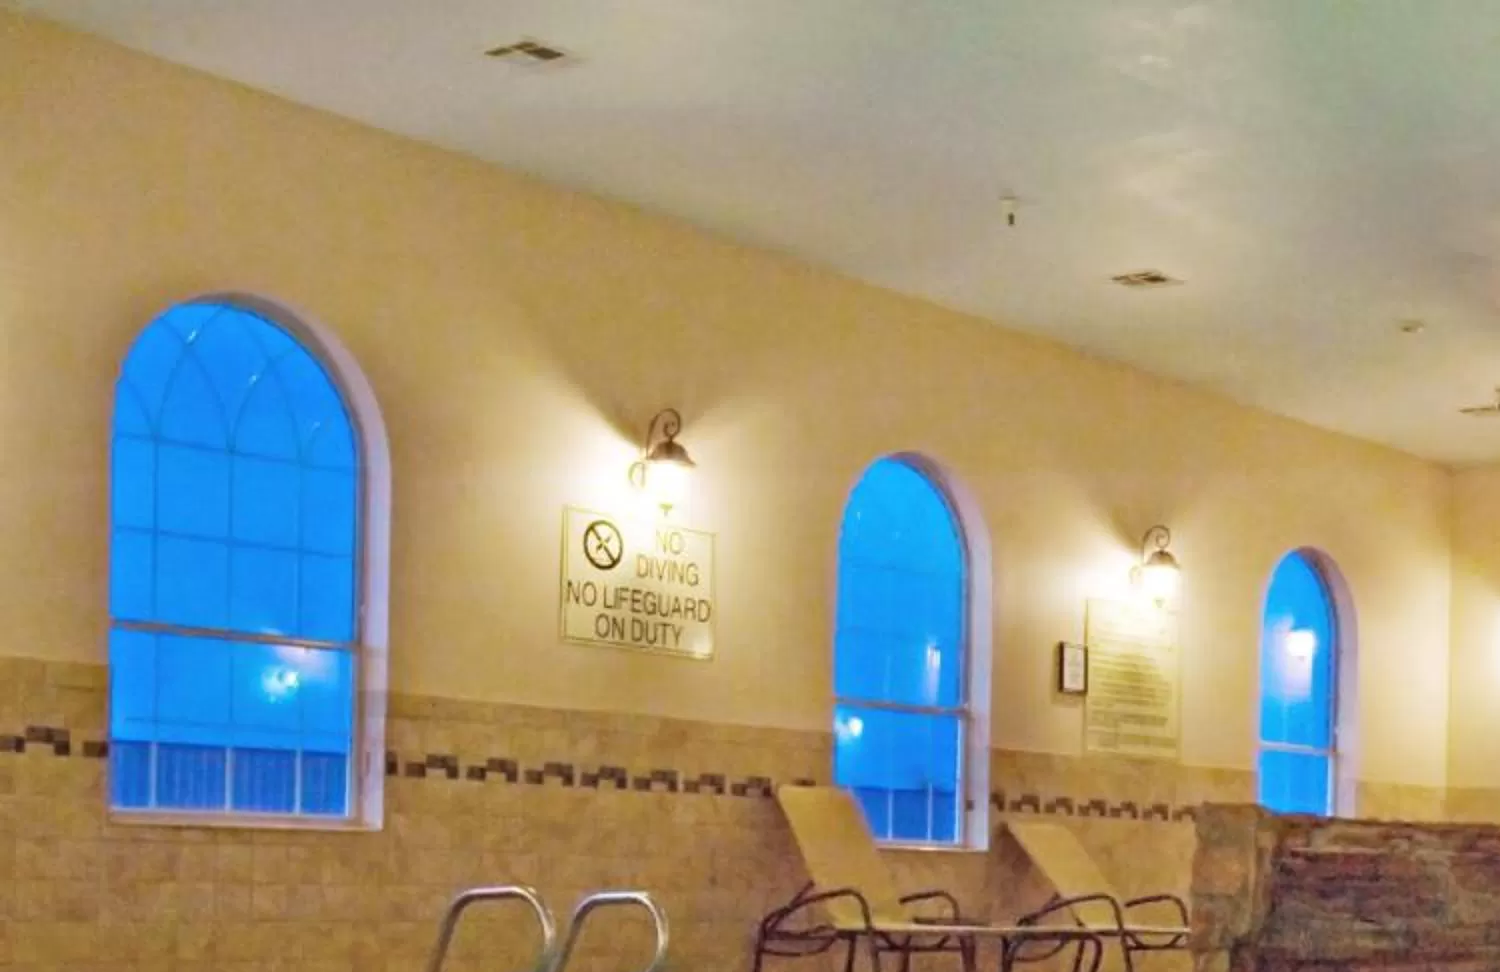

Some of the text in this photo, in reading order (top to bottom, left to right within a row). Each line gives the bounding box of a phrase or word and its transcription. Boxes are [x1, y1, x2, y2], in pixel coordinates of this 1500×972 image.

[656, 530, 685, 554] NO
[636, 553, 699, 586] DIVING
[566, 580, 711, 622] NO LIFEGUARD
[594, 613, 684, 647] ON DUTY
